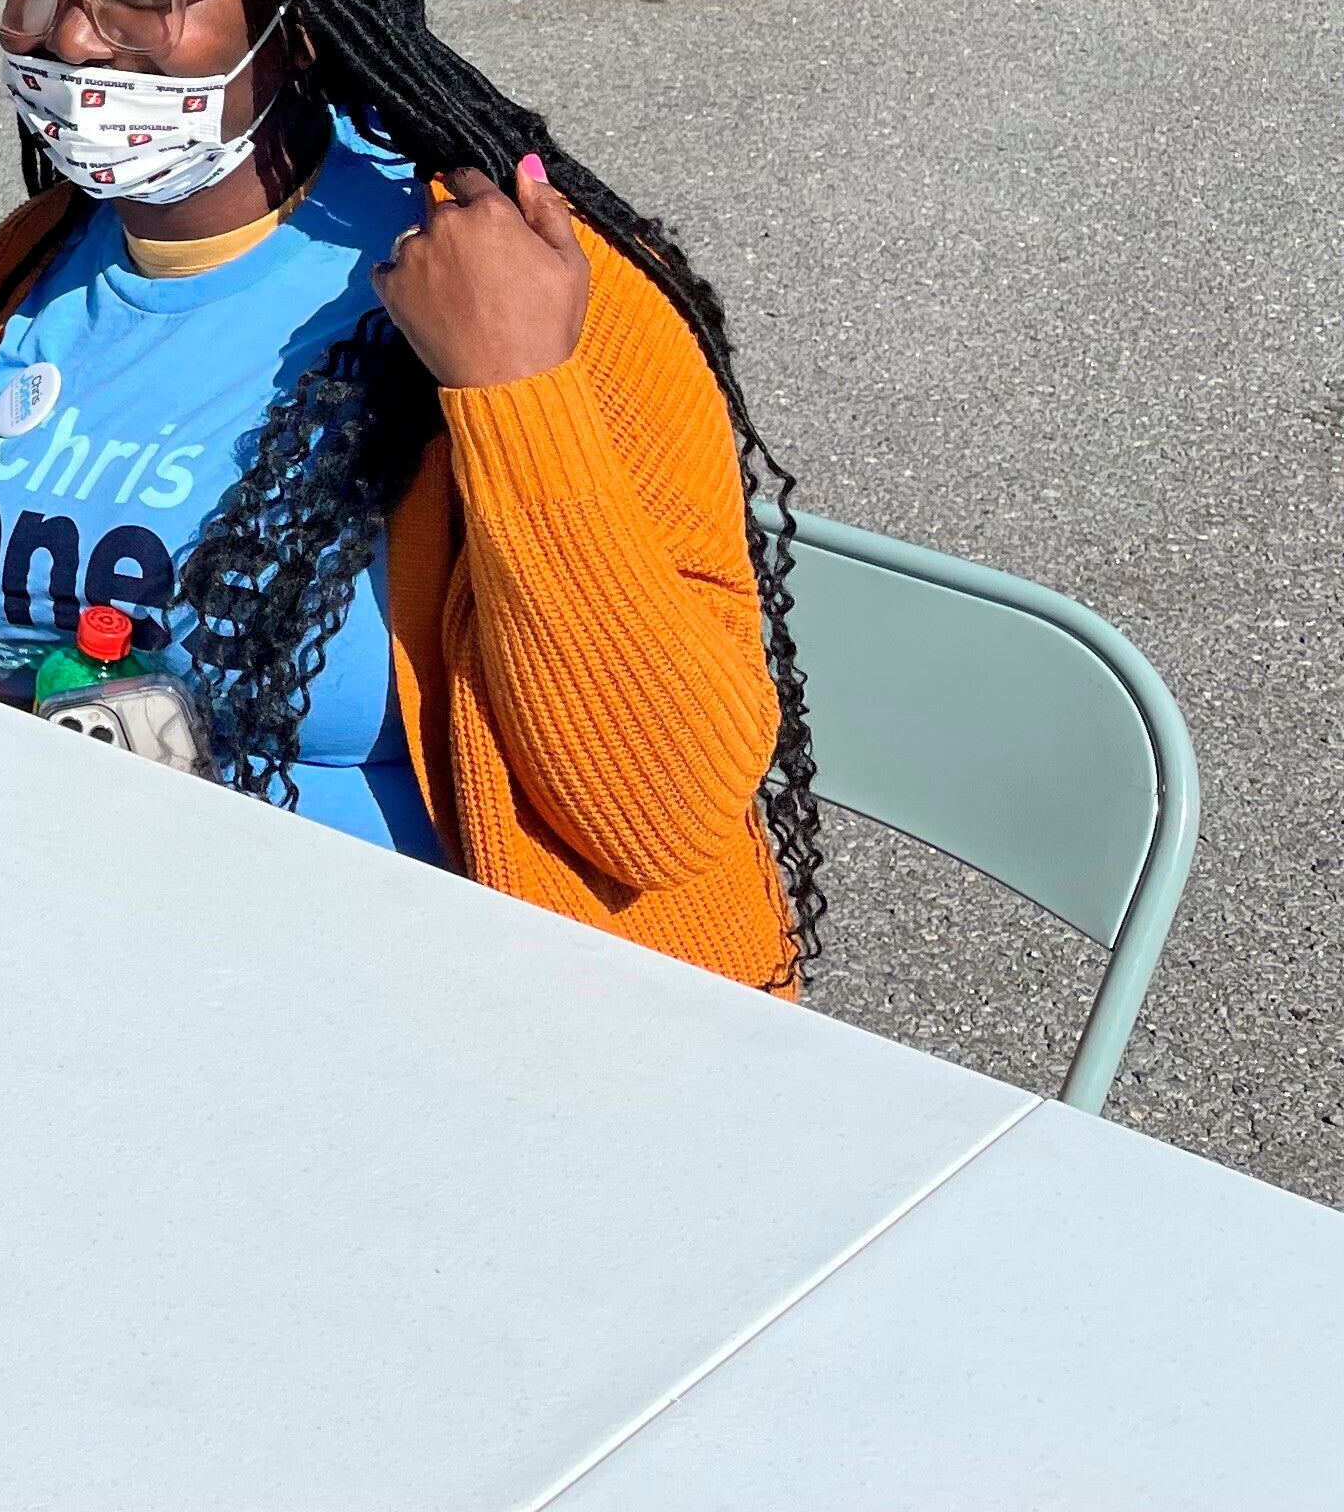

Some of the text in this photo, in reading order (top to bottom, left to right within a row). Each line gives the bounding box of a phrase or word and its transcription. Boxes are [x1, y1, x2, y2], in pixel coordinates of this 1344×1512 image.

[84, 78, 135, 91] Simmons
[98, 123, 179, 132] immons Bank
